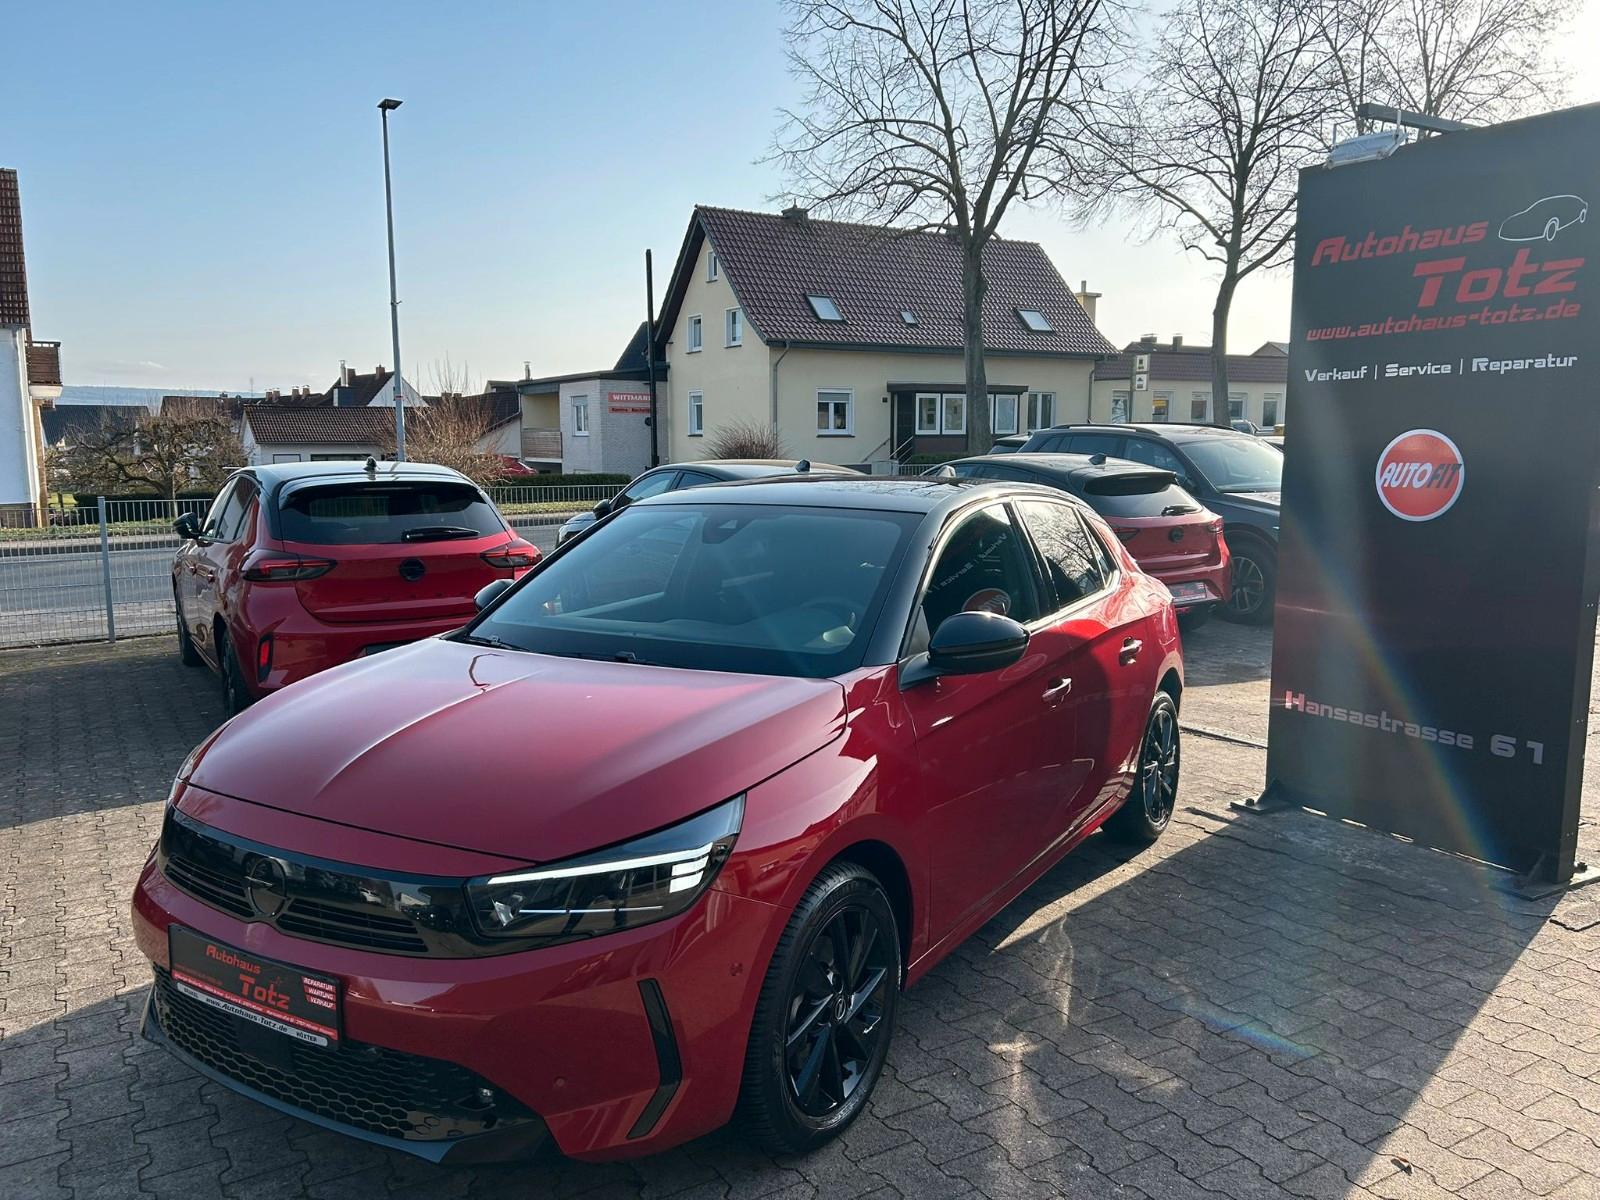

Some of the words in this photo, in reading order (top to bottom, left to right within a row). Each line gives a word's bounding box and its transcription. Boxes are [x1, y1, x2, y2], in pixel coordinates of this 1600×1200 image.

[1312, 221, 1488, 266] Autohaus
[1413, 248, 1584, 307] Totz
[1306, 299, 1581, 341] www.autohaus-totz.de
[1305, 366, 1367, 382] Verkauf
[1385, 362, 1451, 378] Service
[1472, 353, 1578, 374] Reparatur
[1285, 691, 1473, 749] Hansastrasse
[1490, 734, 1544, 765] 61
[206, 944, 261, 974] Autohaus
[239, 973, 290, 1010] Totz
[303, 977, 333, 991] REPARATUR
[308, 987, 334, 1000] WARTUNG
[310, 997, 335, 1008] VERKAUF
